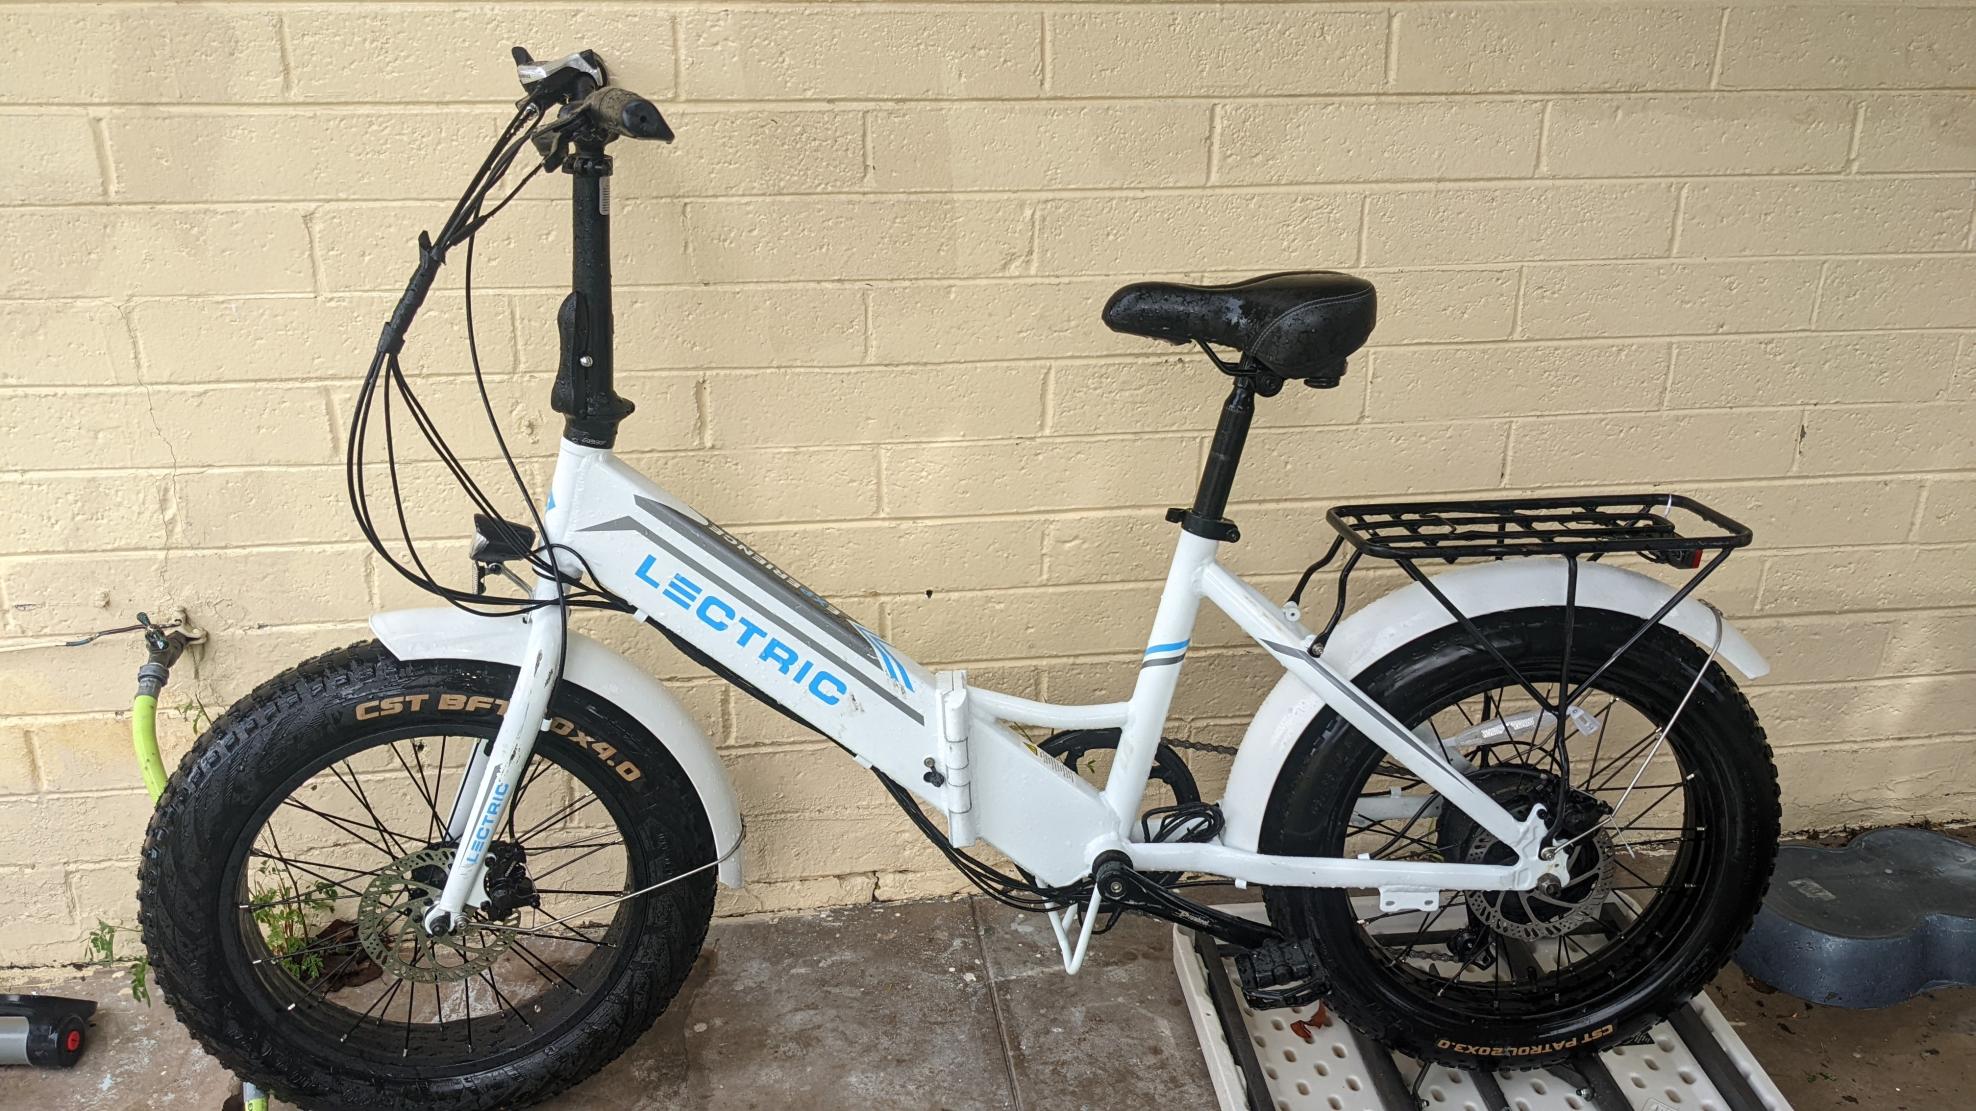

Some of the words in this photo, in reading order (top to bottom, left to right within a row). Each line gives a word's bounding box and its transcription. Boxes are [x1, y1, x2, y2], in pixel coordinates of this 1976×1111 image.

[708, 525, 841, 616] EXPERIENCE
[635, 554, 847, 706] LECTRIC
[355, 694, 430, 721] CST
[549, 716, 641, 782] 0X4.0
[467, 783, 509, 865] LECTRIC
[1437, 1039, 1505, 1057] 20X3.0
[1511, 1036, 1578, 1057] PATROL
[1582, 1024, 1614, 1043] CST
